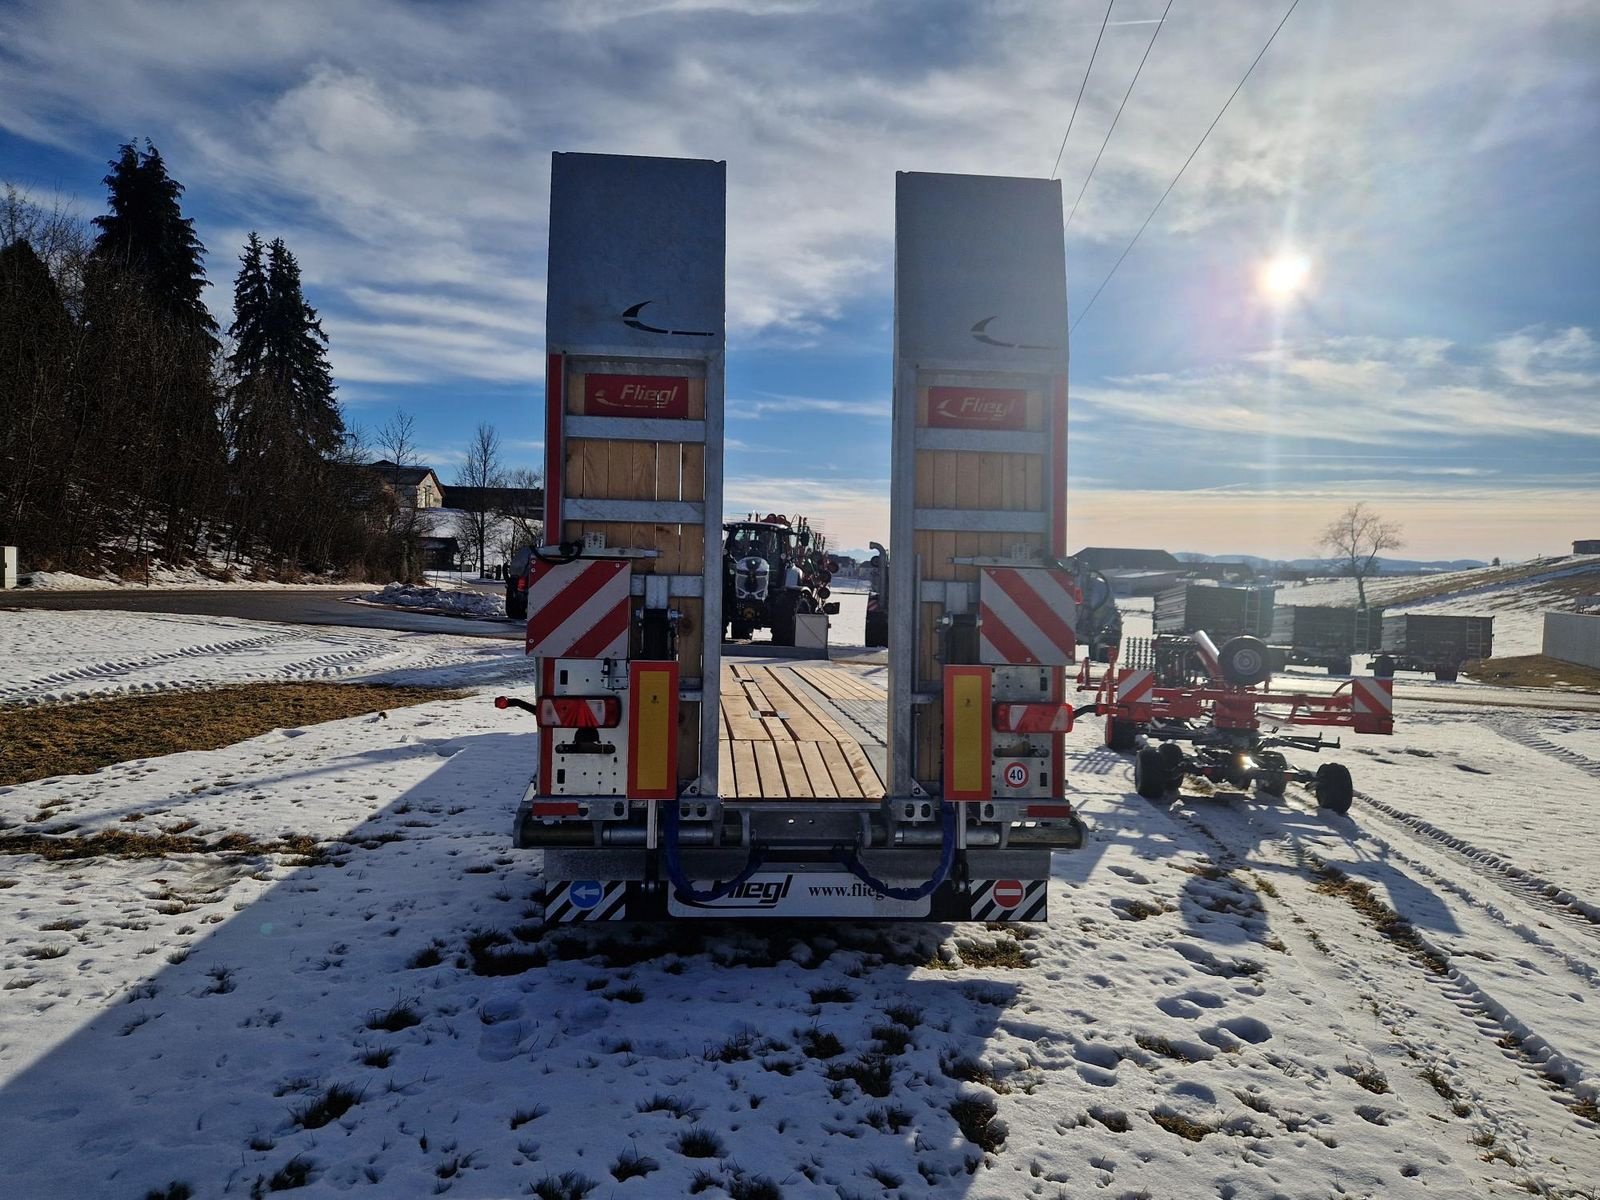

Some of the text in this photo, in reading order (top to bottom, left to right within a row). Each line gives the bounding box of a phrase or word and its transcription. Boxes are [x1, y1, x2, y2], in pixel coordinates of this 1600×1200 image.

[620, 384, 678, 405] Fliegl
[960, 397, 1016, 416] Fliegl
[1010, 769, 1023, 781] 40
